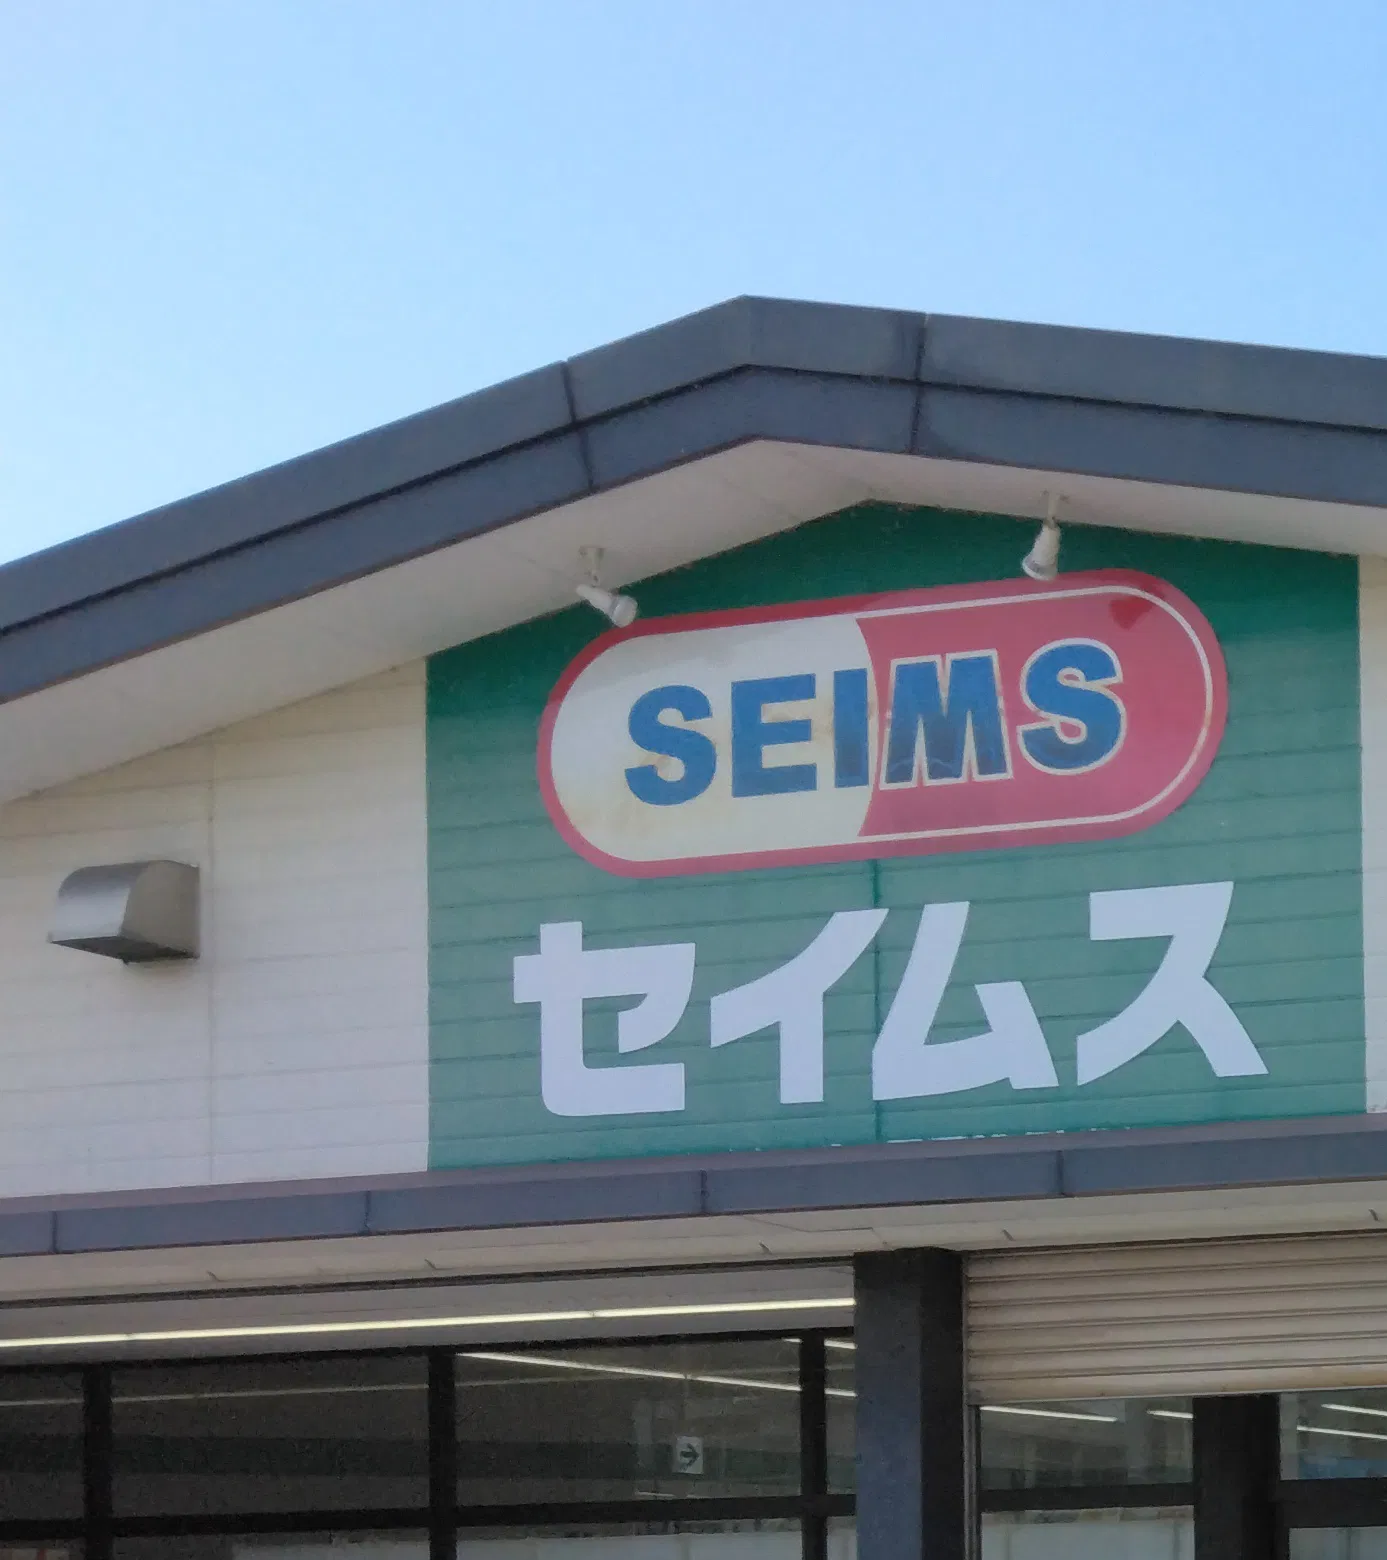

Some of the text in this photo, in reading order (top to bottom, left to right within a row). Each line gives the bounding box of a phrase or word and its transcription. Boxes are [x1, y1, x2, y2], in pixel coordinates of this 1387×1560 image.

[624, 638, 1127, 806] SEIMS
[513, 881, 1269, 1117] セイムス
